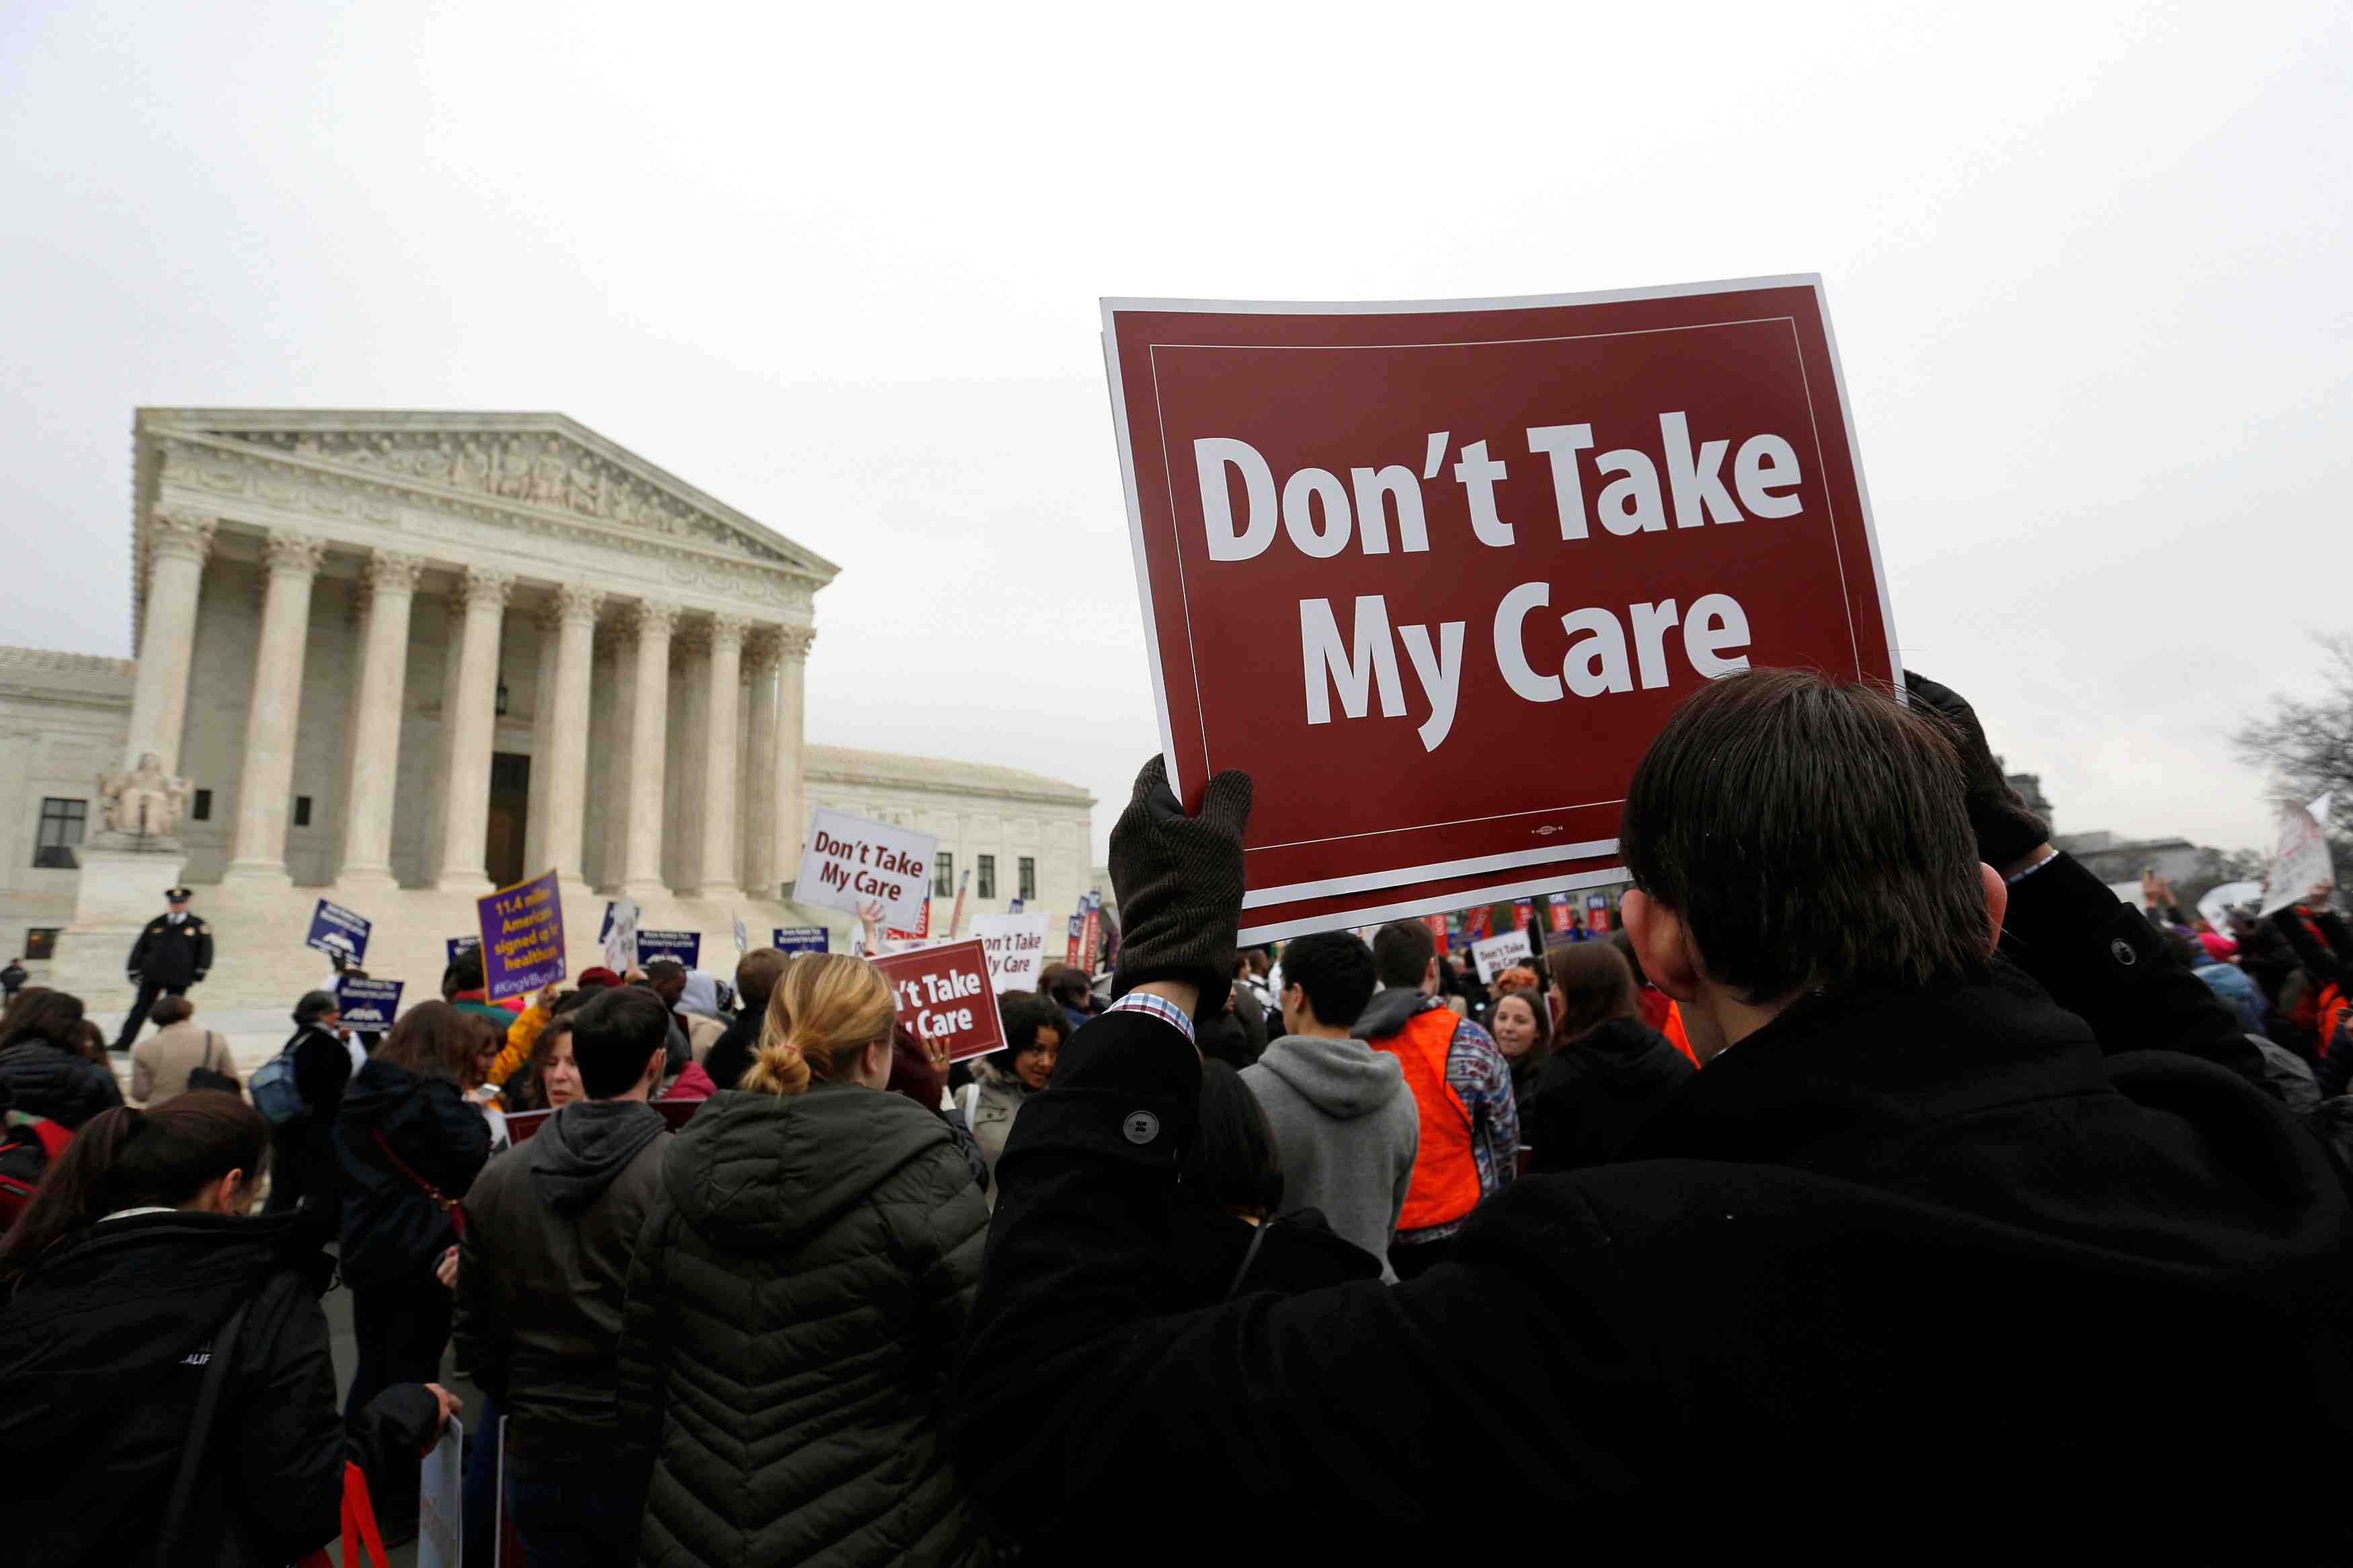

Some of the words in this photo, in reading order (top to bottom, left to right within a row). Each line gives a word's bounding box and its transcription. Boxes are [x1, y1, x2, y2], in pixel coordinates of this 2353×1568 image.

[1193, 430, 1515, 561] Don't
[1526, 411, 1804, 541] Take
[1300, 594, 1466, 753] My
[1493, 581, 1751, 702] Care
[815, 831, 869, 864] Don't
[875, 845, 923, 878] Take
[820, 861, 850, 893] My
[854, 871, 902, 901] Care
[494, 929, 537, 956] signed
[975, 933, 1011, 950] on't
[1015, 932, 1041, 950] Take
[1004, 956, 1030, 973] Care
[922, 968, 982, 1004] Take
[917, 1008, 973, 1039] Care
